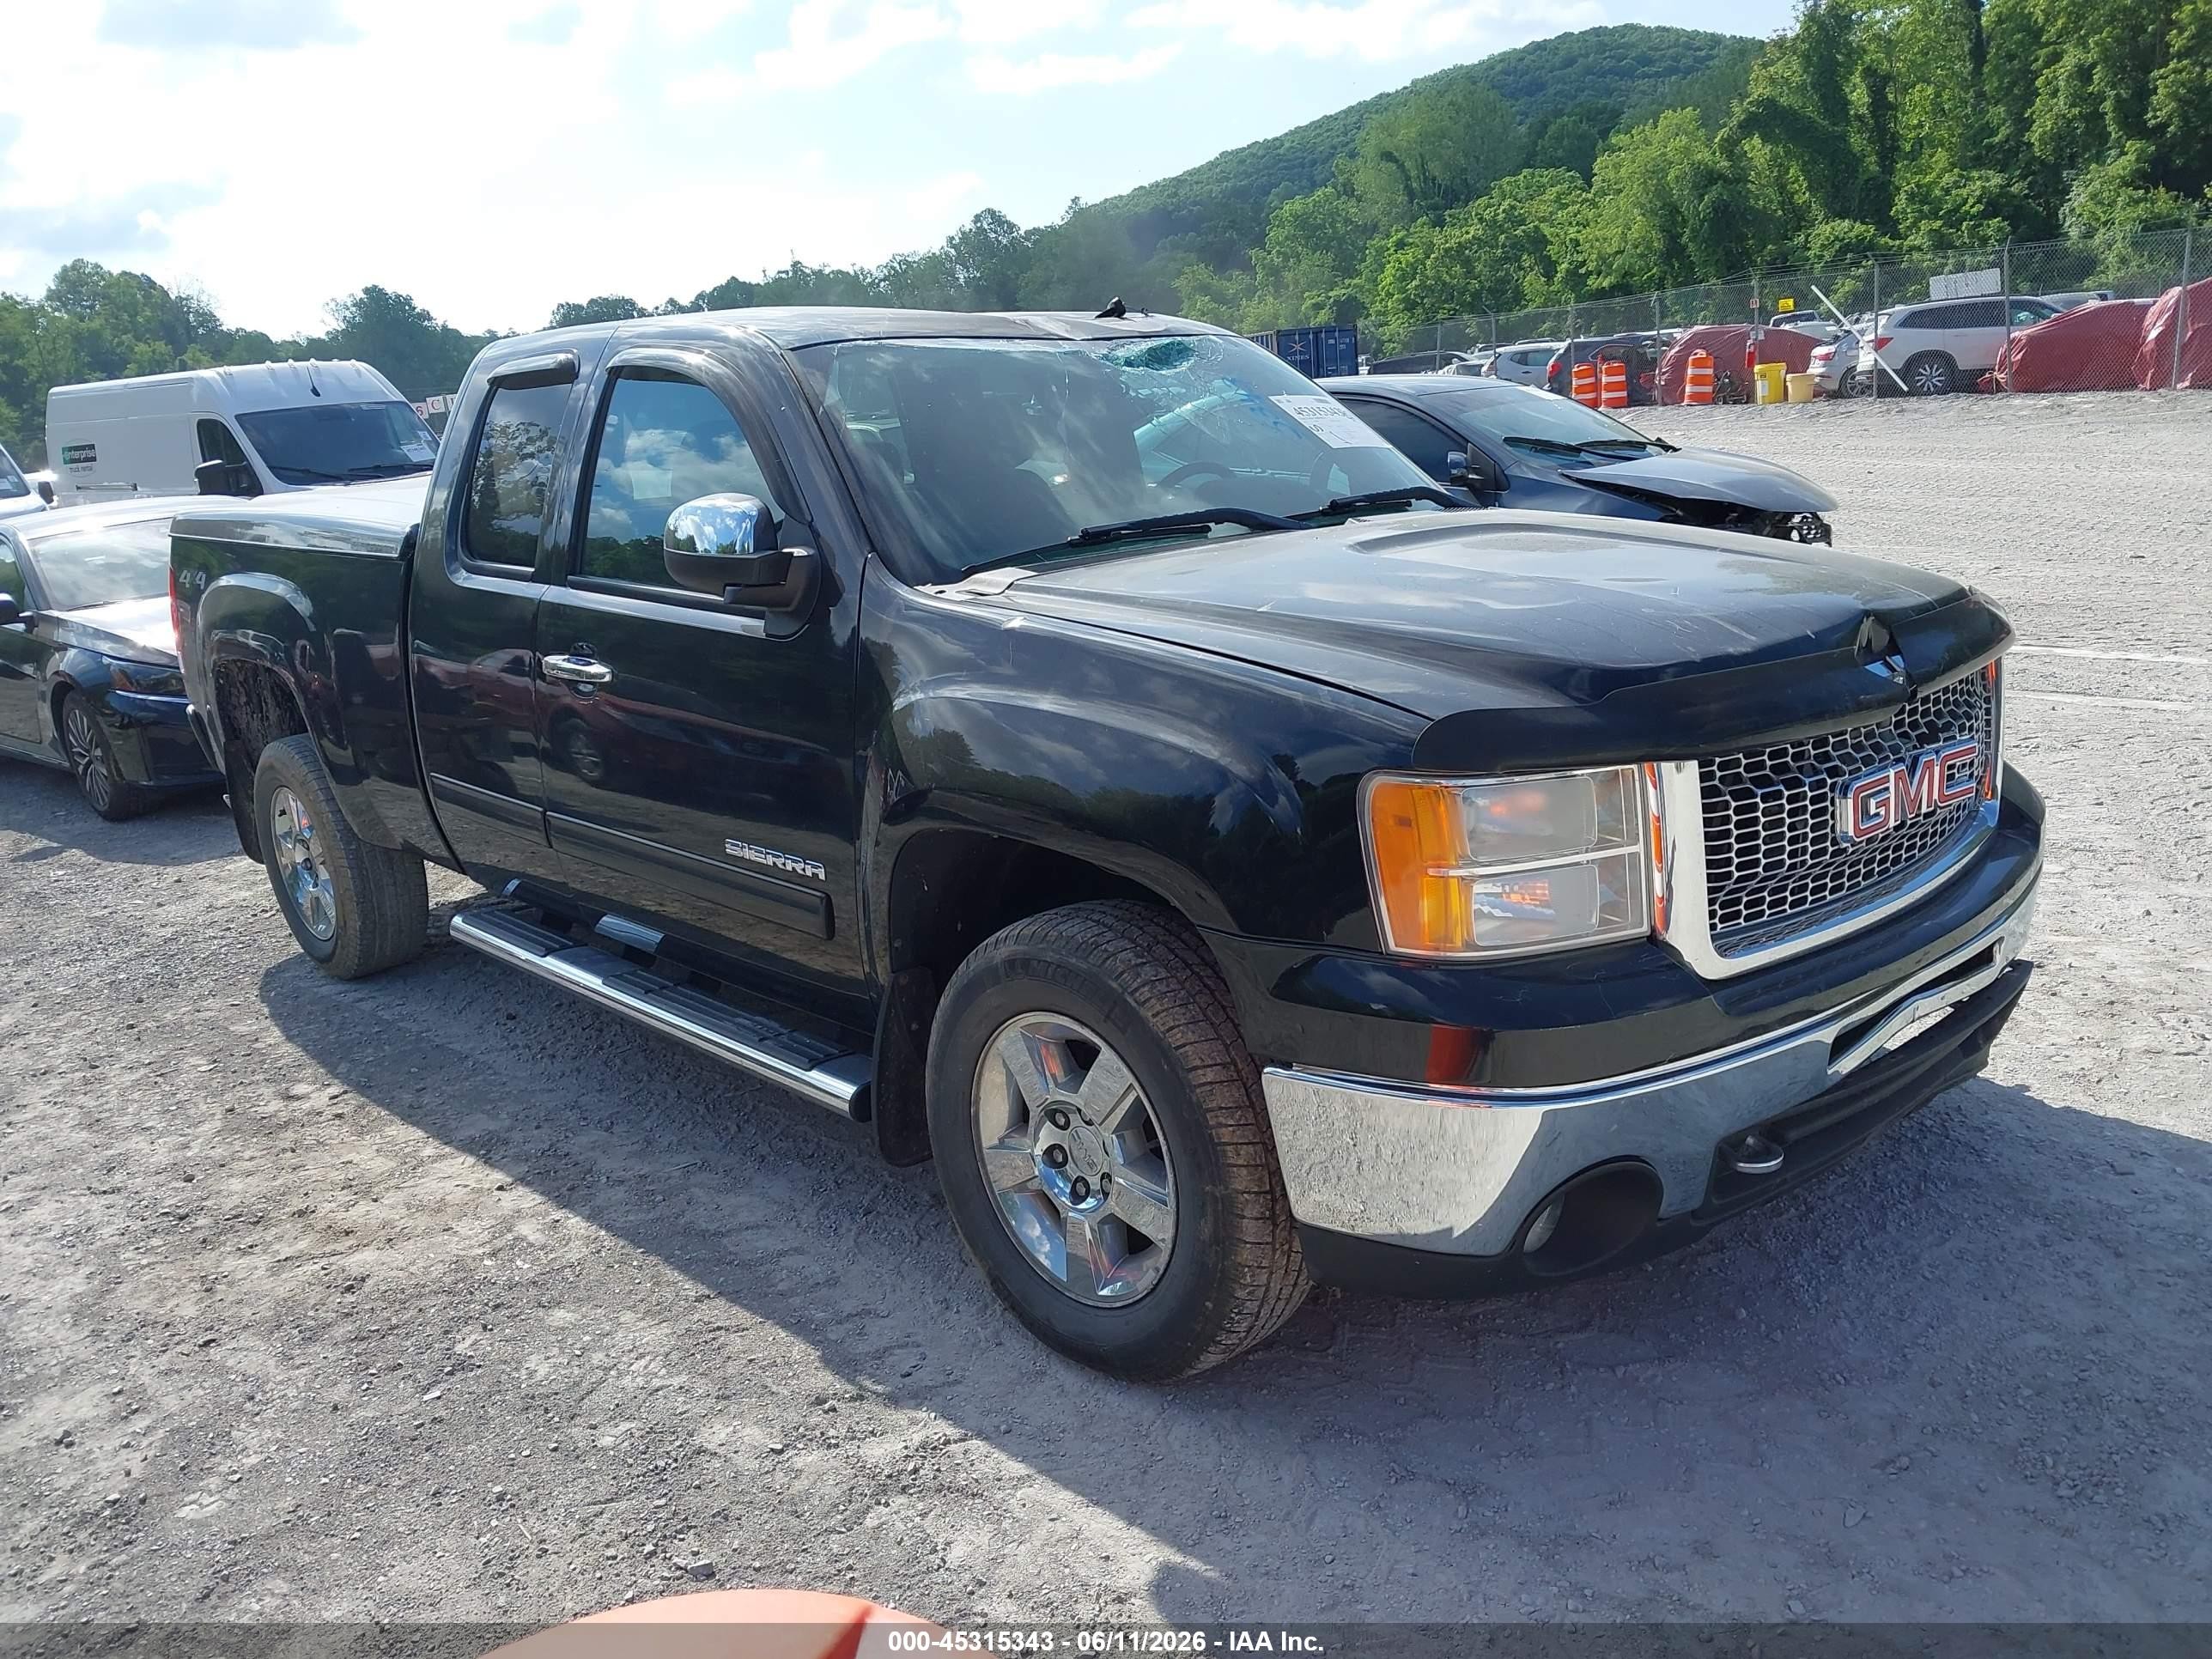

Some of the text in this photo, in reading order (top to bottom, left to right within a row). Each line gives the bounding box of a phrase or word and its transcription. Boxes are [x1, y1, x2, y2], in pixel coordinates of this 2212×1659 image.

[431, 399, 441, 410] C
[63, 447, 96, 461] enterprise
[1852, 743, 1978, 842] GMC
[724, 838, 826, 881] SIERRA
